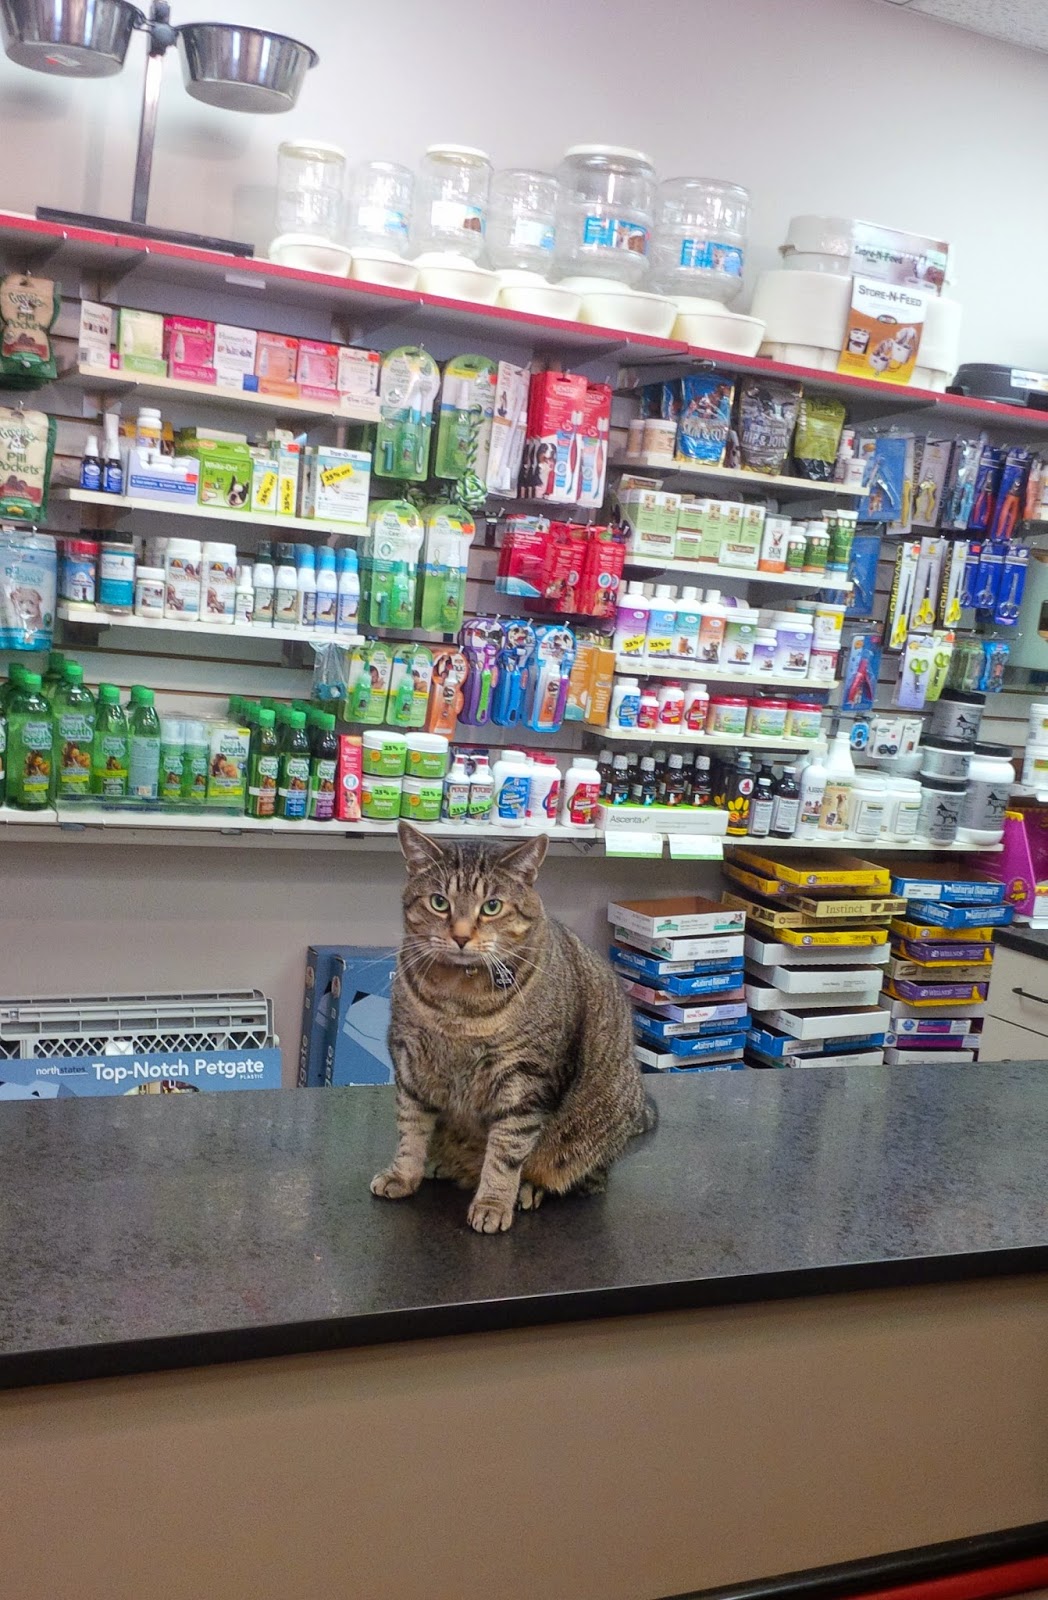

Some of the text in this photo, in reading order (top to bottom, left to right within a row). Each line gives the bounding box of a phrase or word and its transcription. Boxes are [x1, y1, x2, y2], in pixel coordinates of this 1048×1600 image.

[7, 452, 27, 463] Pill
[219, 744, 246, 755] breath
[610, 814, 642, 824] Ascenta
[826, 904, 865, 914] Instinct
[92, 1058, 265, 1084] Top-Notch Petgate
